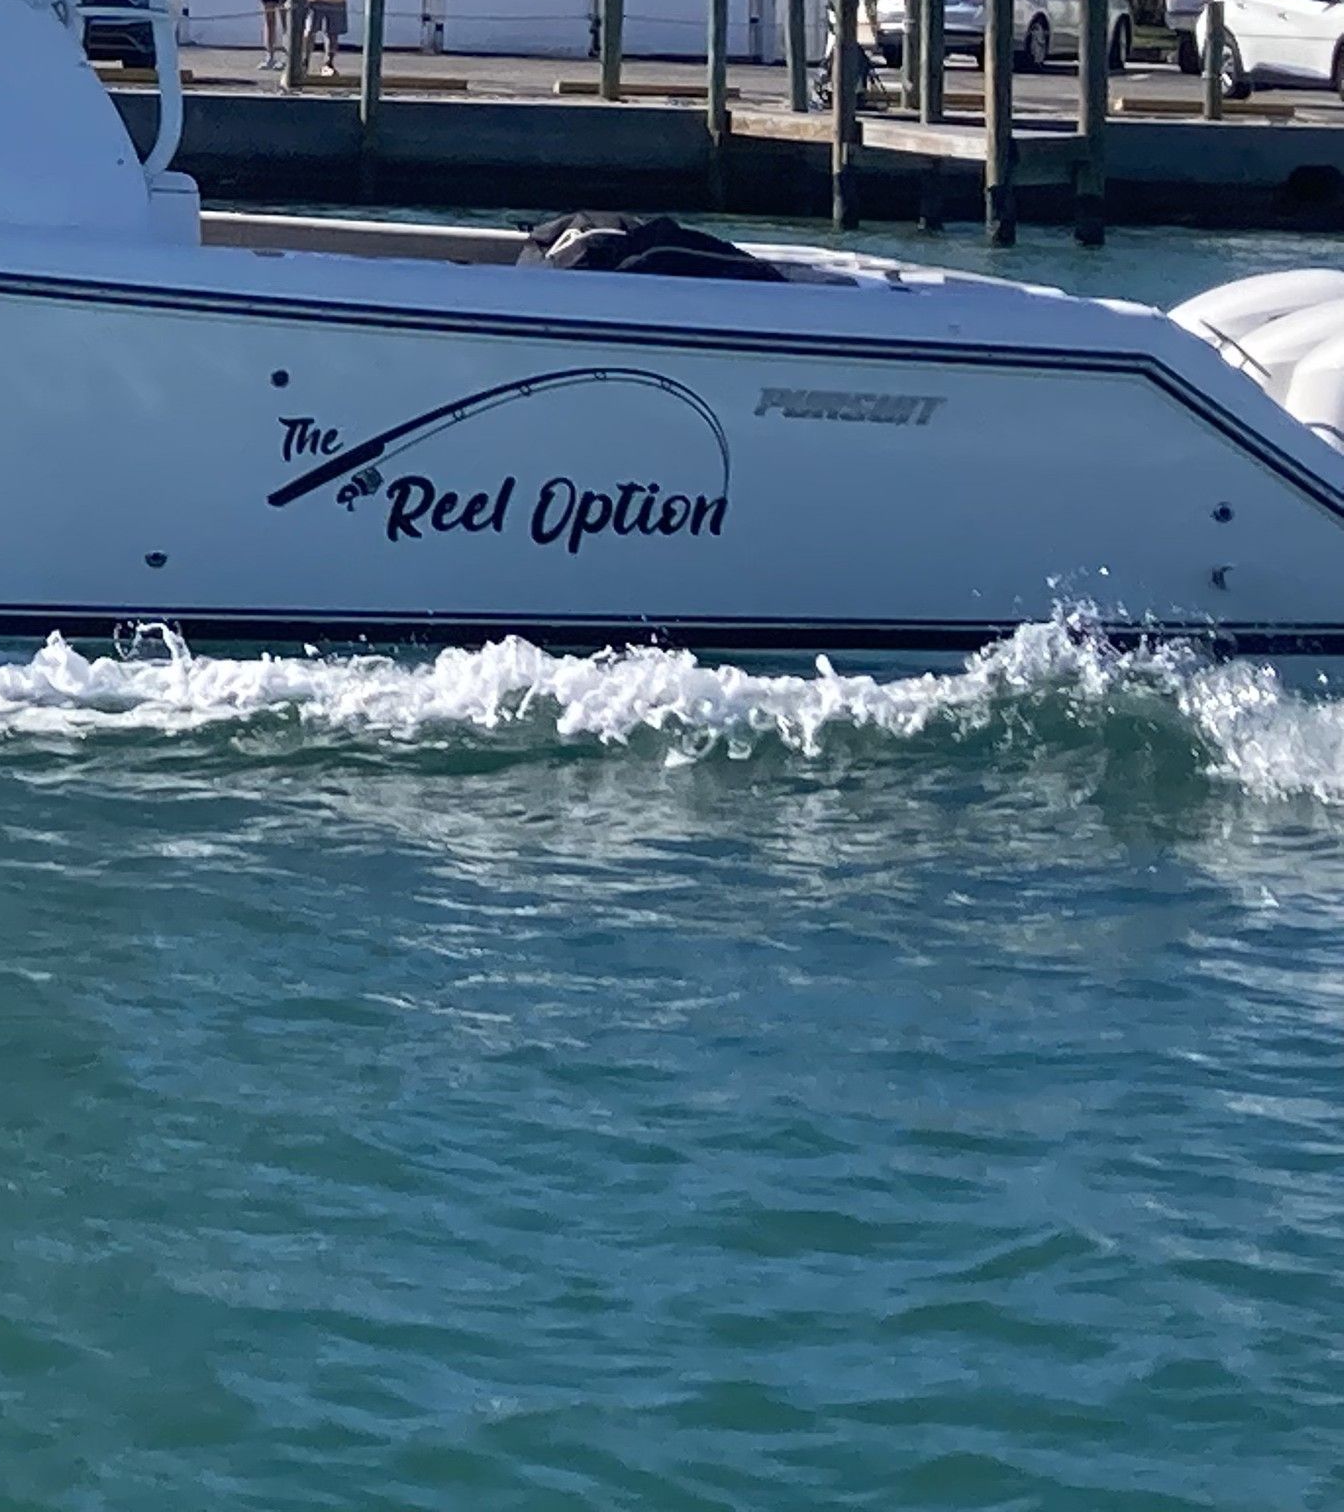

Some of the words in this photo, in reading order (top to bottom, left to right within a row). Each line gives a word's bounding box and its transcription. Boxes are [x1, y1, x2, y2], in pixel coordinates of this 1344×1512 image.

[753, 387, 948, 426] PURSUIT
[279, 416, 344, 462] The
[386, 476, 516, 542] Reel
[530, 477, 728, 554] Option
